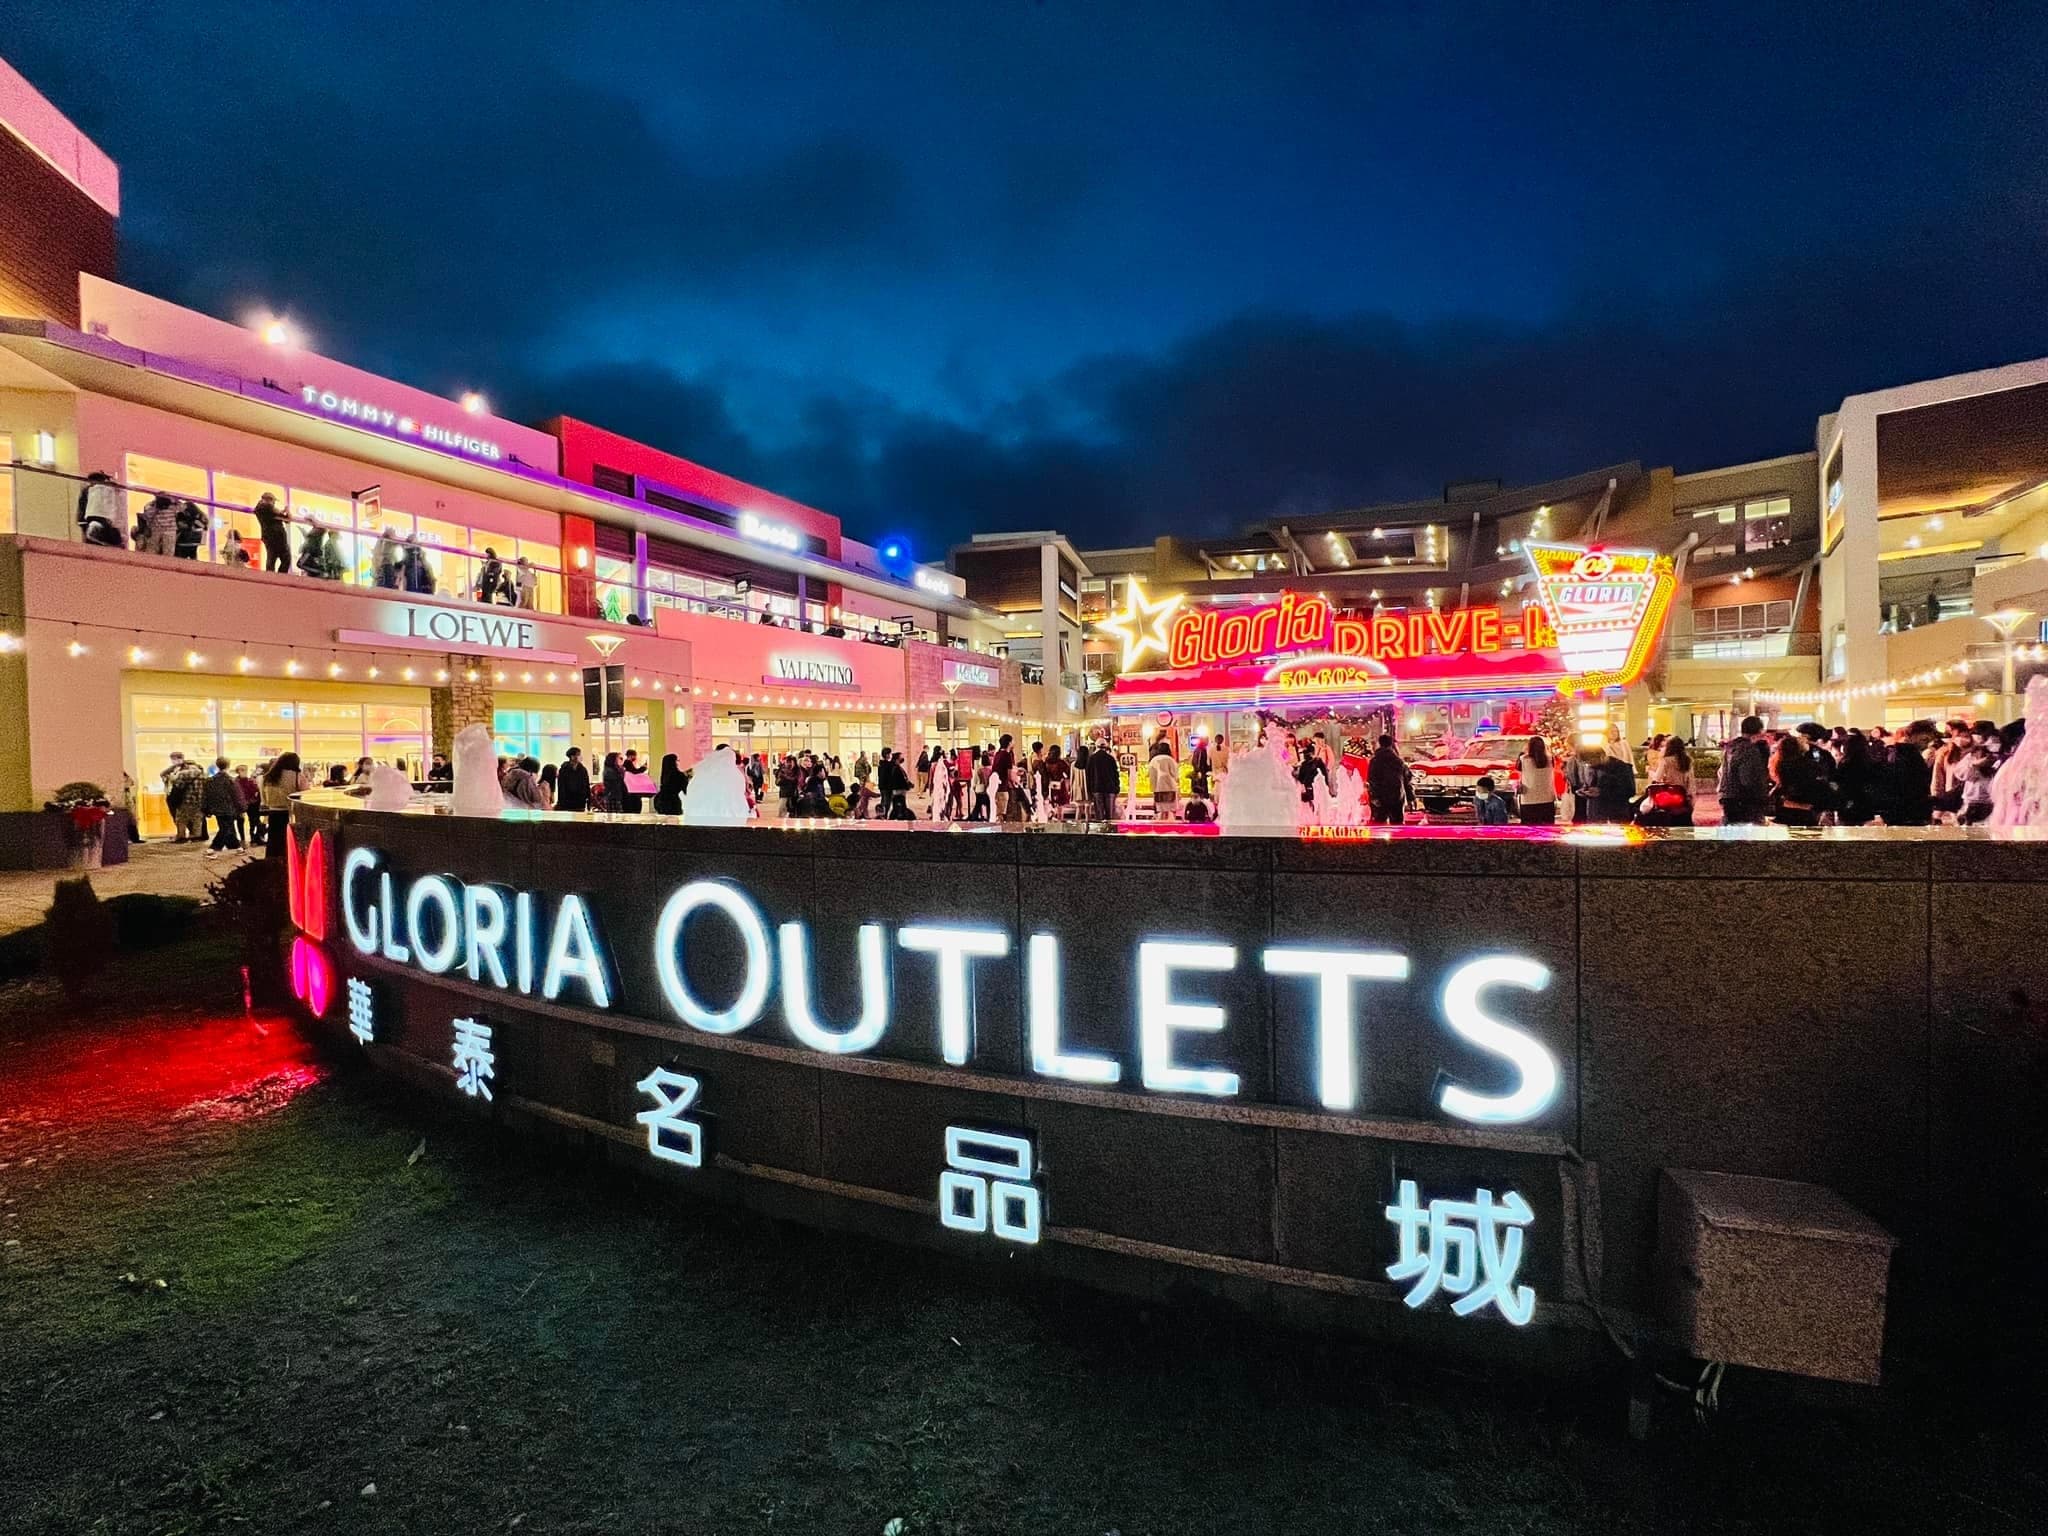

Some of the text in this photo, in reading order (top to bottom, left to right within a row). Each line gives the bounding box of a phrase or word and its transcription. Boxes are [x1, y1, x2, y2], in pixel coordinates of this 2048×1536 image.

[303, 387, 500, 460] TOMMY HILFIGER
[408, 608, 534, 650] LOEWE
[1169, 592, 1327, 668] Gloria
[1559, 585, 1634, 603] GLORIA
[779, 658, 853, 685] VALENTINO
[342, 847, 1562, 1125] GLORIA OUTLETS
[347, 976, 1537, 1327] 華泰名品城
